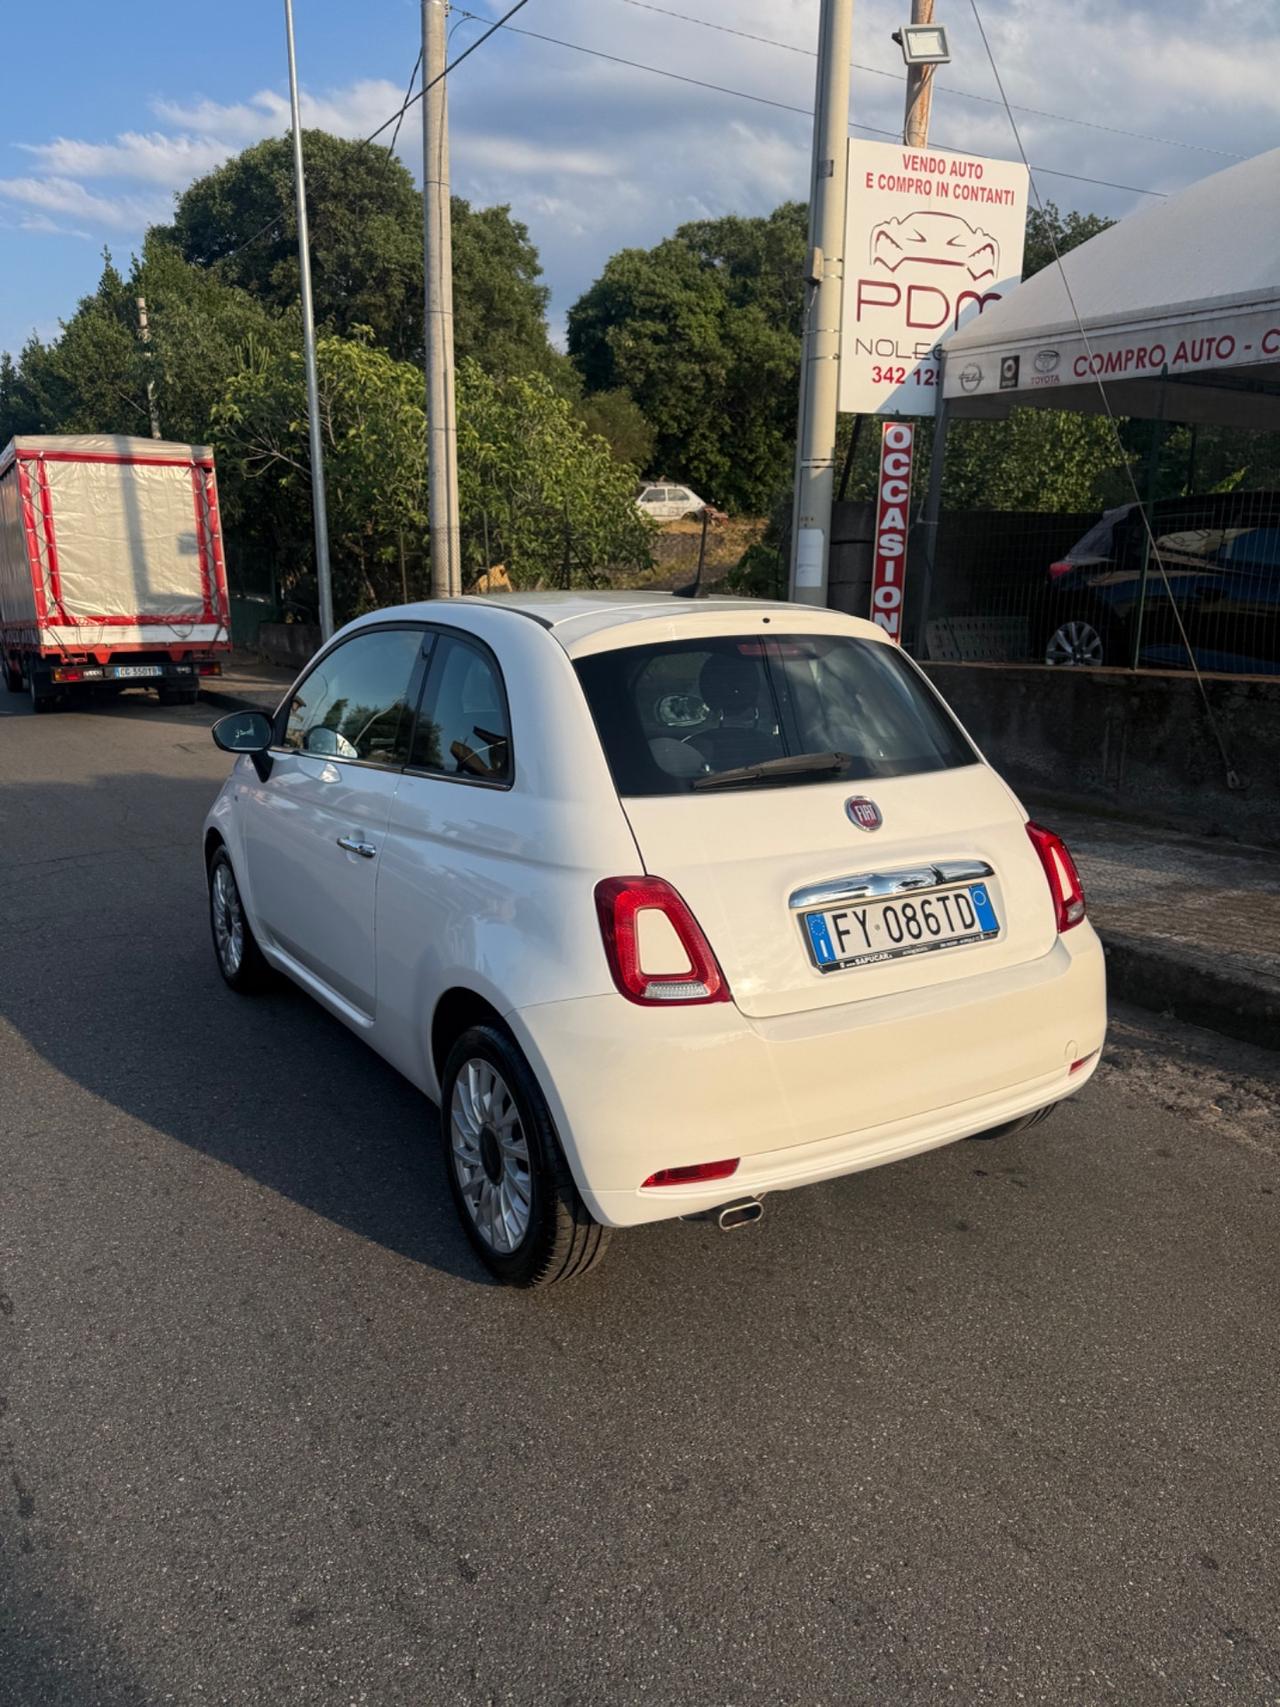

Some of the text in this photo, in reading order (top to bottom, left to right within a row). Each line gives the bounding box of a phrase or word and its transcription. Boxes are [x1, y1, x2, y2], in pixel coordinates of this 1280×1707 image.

[902, 153, 984, 180] VENDO AUTO
[865, 172, 1015, 206] E COMPRO IN CONTANTI
[1073, 344, 1165, 377] COMPRO
[1172, 335, 1236, 365] AUTO
[871, 366, 906, 385] 342
[1031, 375, 1060, 385] TOYOTA
[854, 804, 878, 822] FIAT
[832, 909, 872, 954] FY
[882, 893, 976, 943] 086TD
